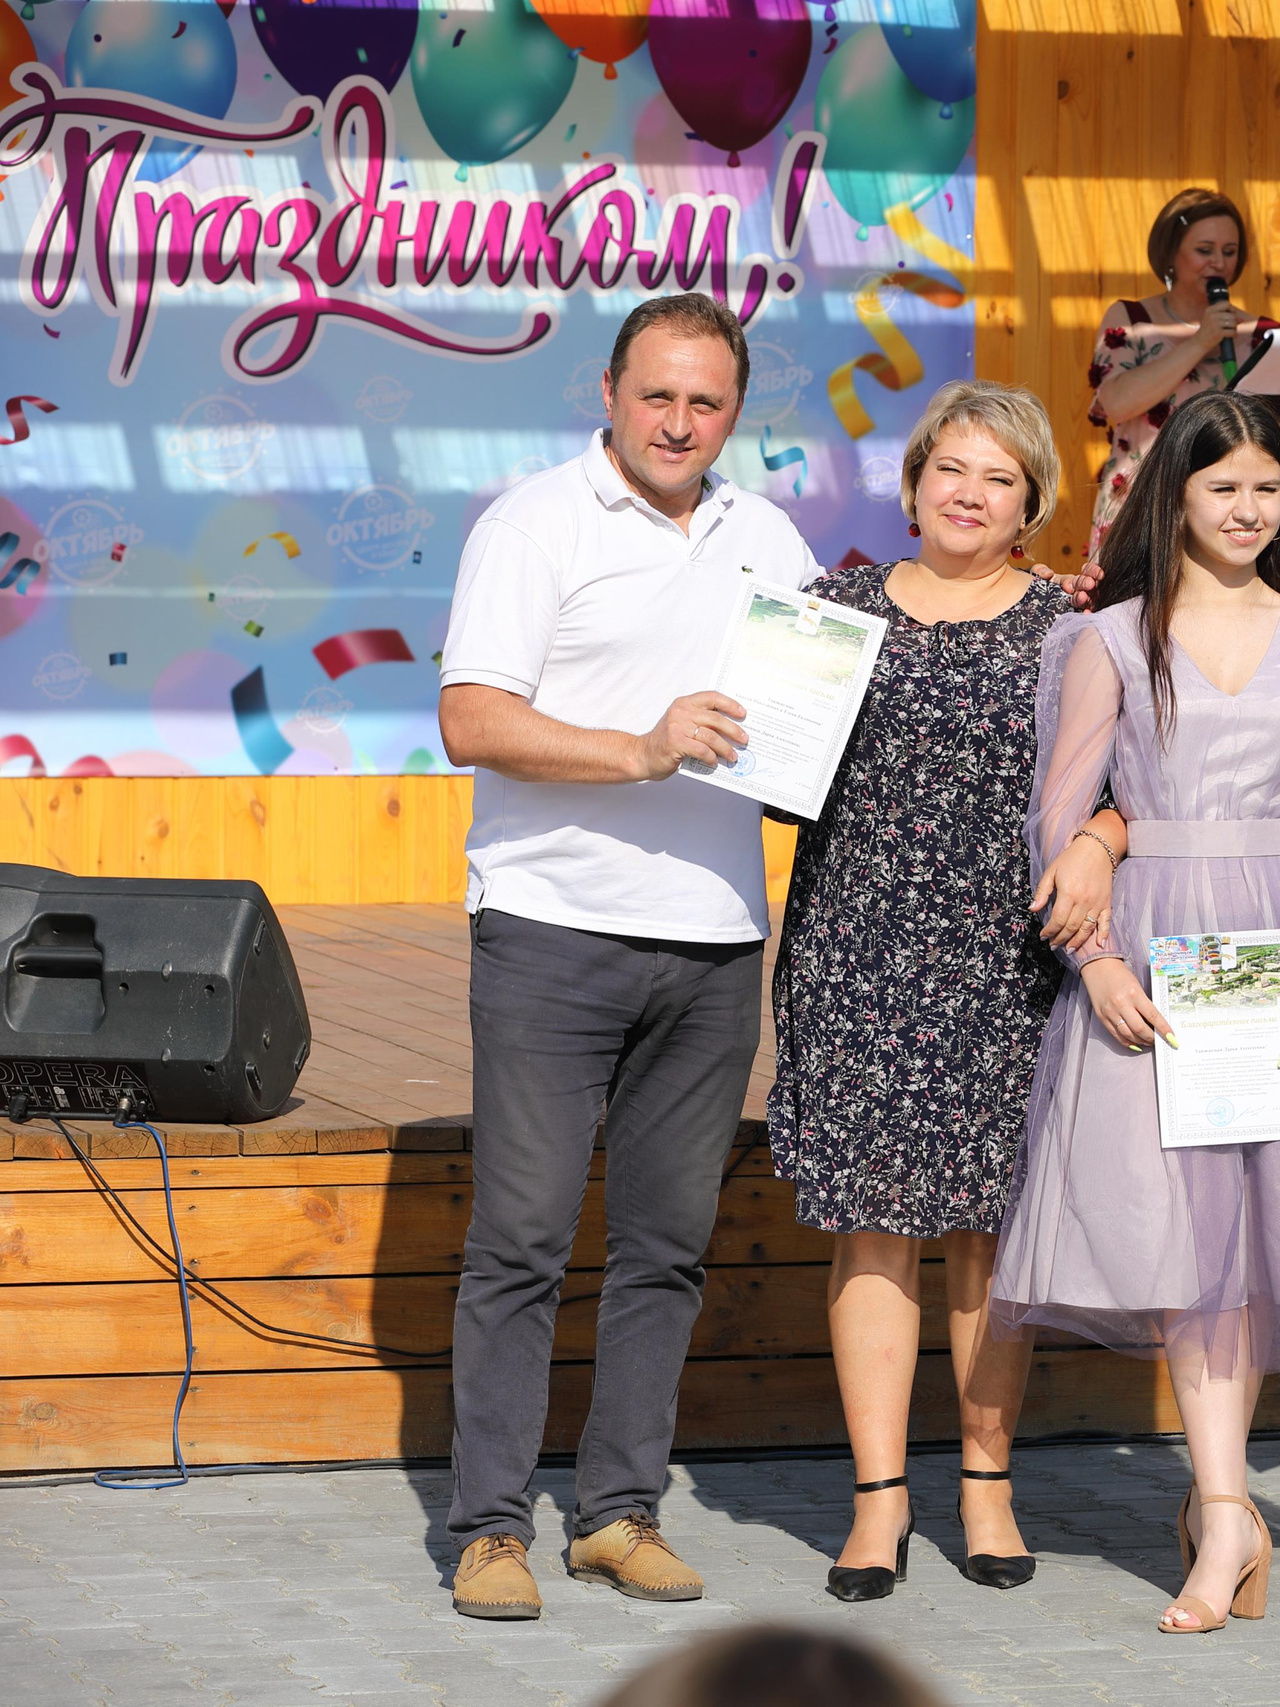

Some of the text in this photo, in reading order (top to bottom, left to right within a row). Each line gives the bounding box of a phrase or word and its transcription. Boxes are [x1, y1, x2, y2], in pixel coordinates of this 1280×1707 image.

[750, 364, 814, 396] ЯБРЬ
[355, 389, 414, 410] ОКТЯБРЬ
[166, 417, 277, 458] ОКТЯБРЬ
[33, 522, 145, 563] ОКТЯБРЬ
[326, 505, 436, 547] ОКТЯБРЬ
[31, 665, 93, 688] ОКТЯБРЬ
